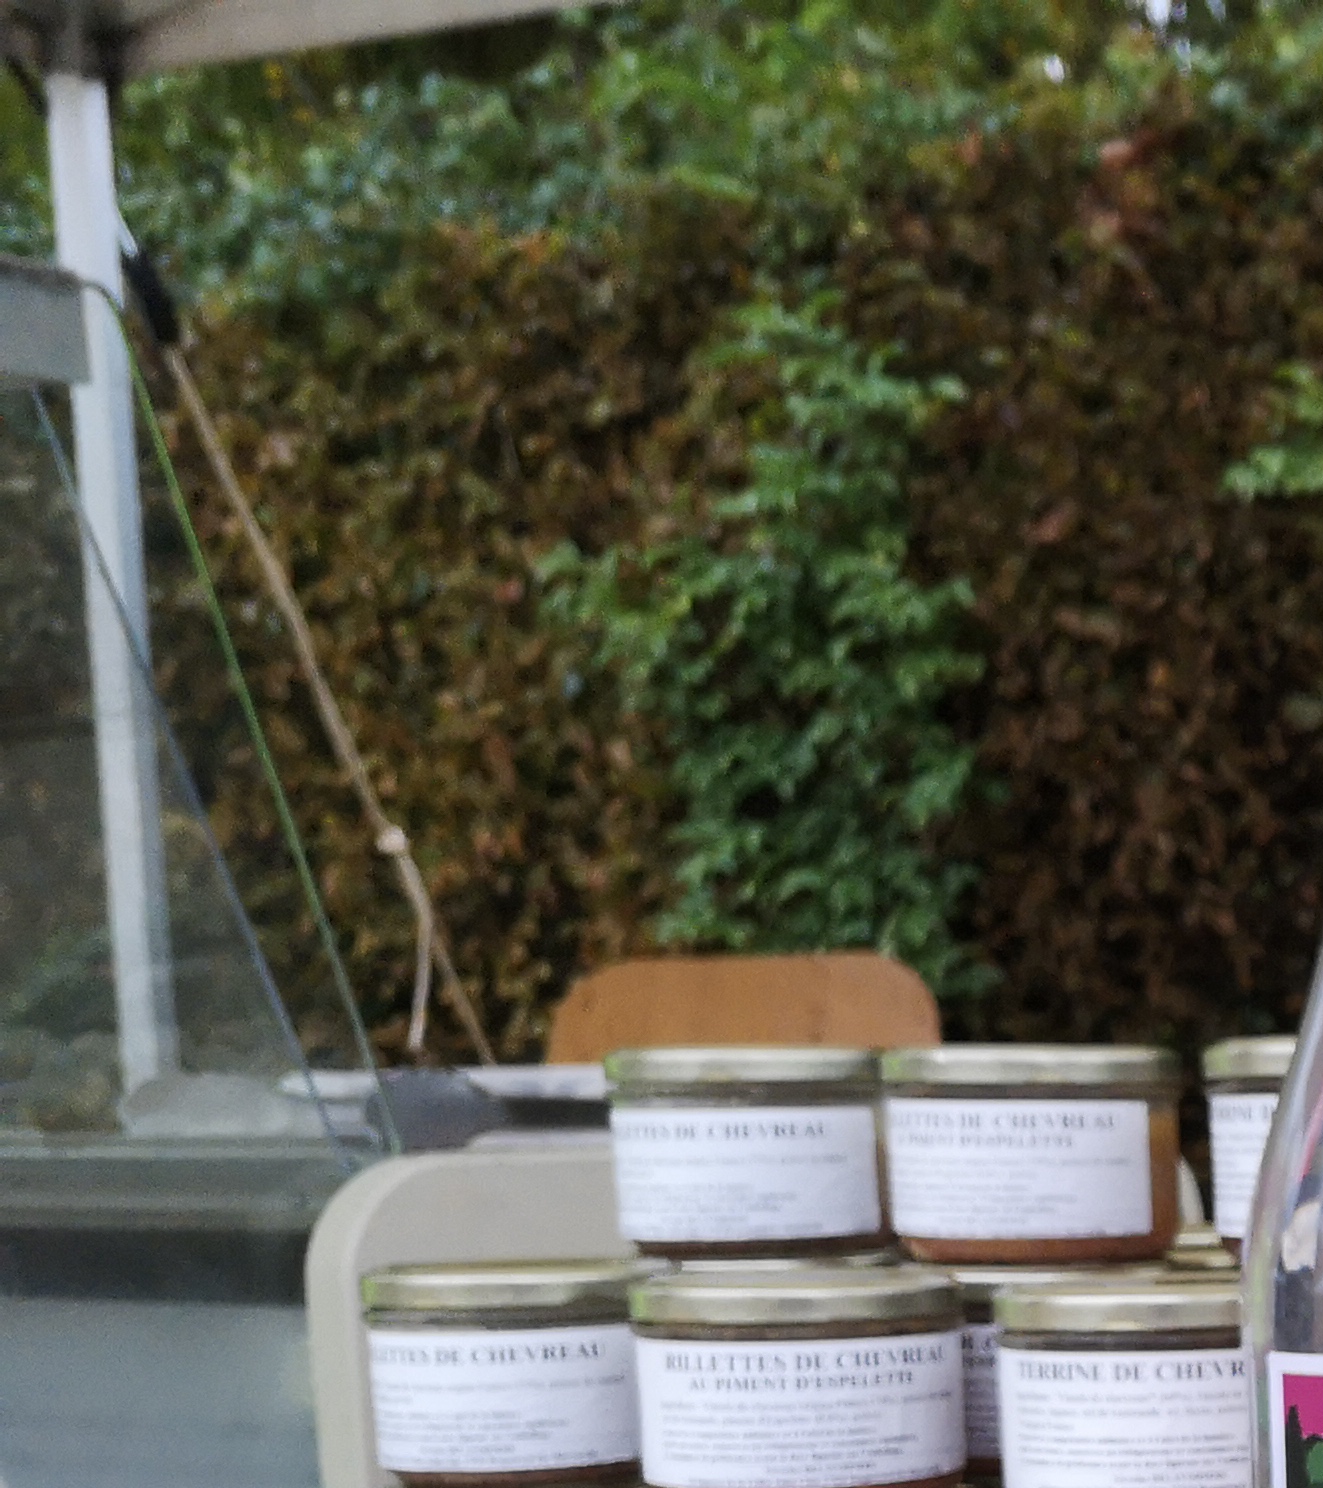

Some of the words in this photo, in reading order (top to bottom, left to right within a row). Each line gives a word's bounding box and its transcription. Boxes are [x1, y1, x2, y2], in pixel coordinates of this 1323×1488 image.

[705, 1119, 829, 1139] CHEVREAU
[992, 1112, 1117, 1130] CHEVREAU
[470, 1341, 605, 1364] CHEVREAU
[664, 1351, 788, 1373] RILLETTES
[795, 1352, 822, 1371] DE
[835, 1344, 946, 1369] CHEVREAU
[1016, 1360, 1103, 1382] TERRINE
[1114, 1362, 1142, 1382] DE
[1155, 1360, 1246, 1381] CHEVR
